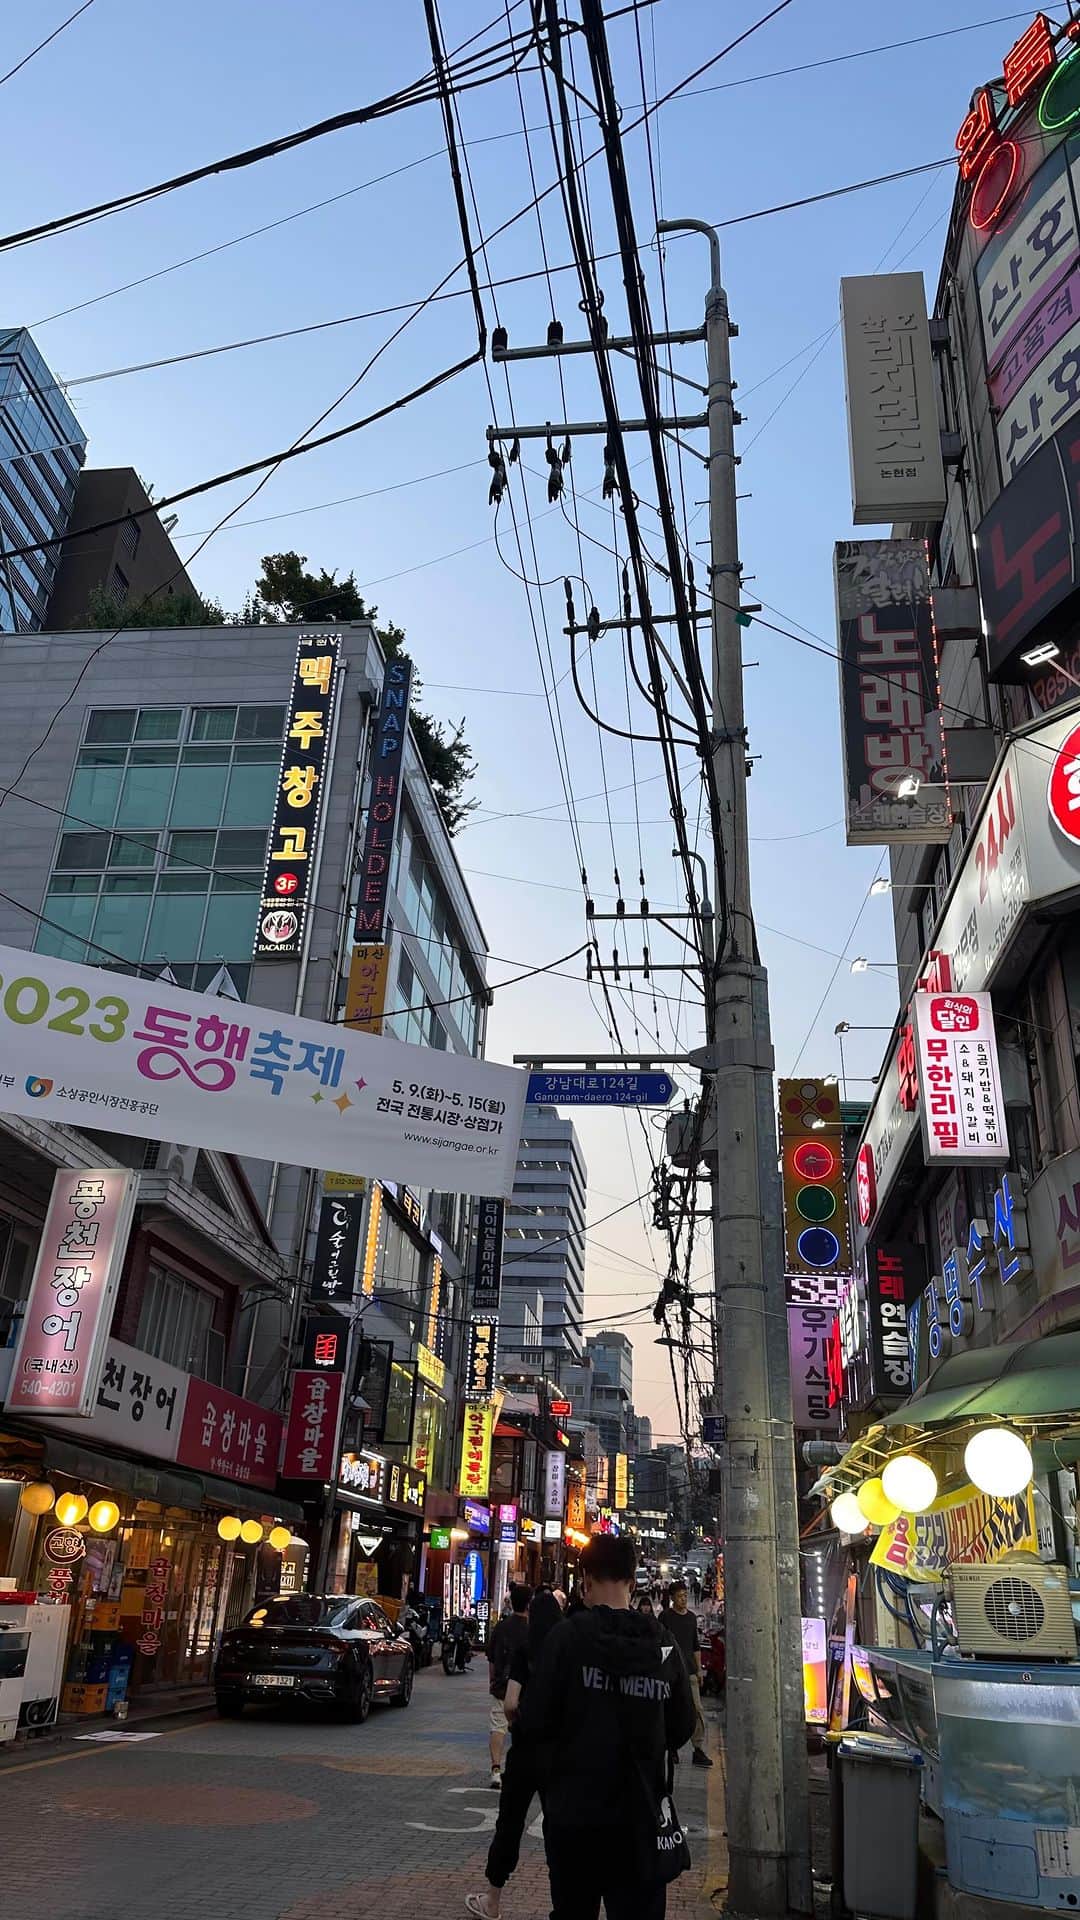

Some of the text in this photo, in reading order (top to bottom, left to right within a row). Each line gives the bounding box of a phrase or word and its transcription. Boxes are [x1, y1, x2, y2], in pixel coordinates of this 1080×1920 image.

[988, 195, 1074, 338] 산호
[1002, 284, 1074, 393] 고품격
[381, 664, 406, 758] SNAP
[857, 613, 932, 796] 노래방
[271, 655, 333, 861] 맥주창고
[357, 775, 394, 930] HOLDEM
[975, 768, 1016, 905] 24시
[276, 876, 298, 891] 3F
[357, 948, 385, 960] 마산
[0, 974, 346, 1096] 023 동행축제
[936, 1010, 970, 1031] 달인
[944, 999, 973, 1014] 회식의
[56, 1086, 159, 1115] 소상공인시장진흥공단
[376, 1097, 403, 1116] 전국
[534, 1092, 649, 1104] Gangnam-daero 124-gil
[659, 1083, 666, 1095] 9
[926, 1039, 960, 1149] 무한리필
[403, 1131, 499, 1156] www.sijangae.or.kr
[42, 1180, 106, 1351] 풍천장어
[481, 1203, 498, 1288] 타이전통마사지
[876, 1248, 912, 1387] 노래연습장
[20, 1380, 76, 1397] 540-4201
[23, 1359, 80, 1375] (국내산)
[471, 1325, 491, 1391] 맥주창고
[96, 1357, 178, 1431] 천장어
[298, 1377, 330, 1473] 곱창마을
[202, 1401, 268, 1464] 곱창마을
[51, 1537, 80, 1554] 고향
[136, 1558, 172, 1656] 곱창마을
[582, 1666, 671, 1699] VEMENTS
[1023, 1673, 1031, 1682] 8
